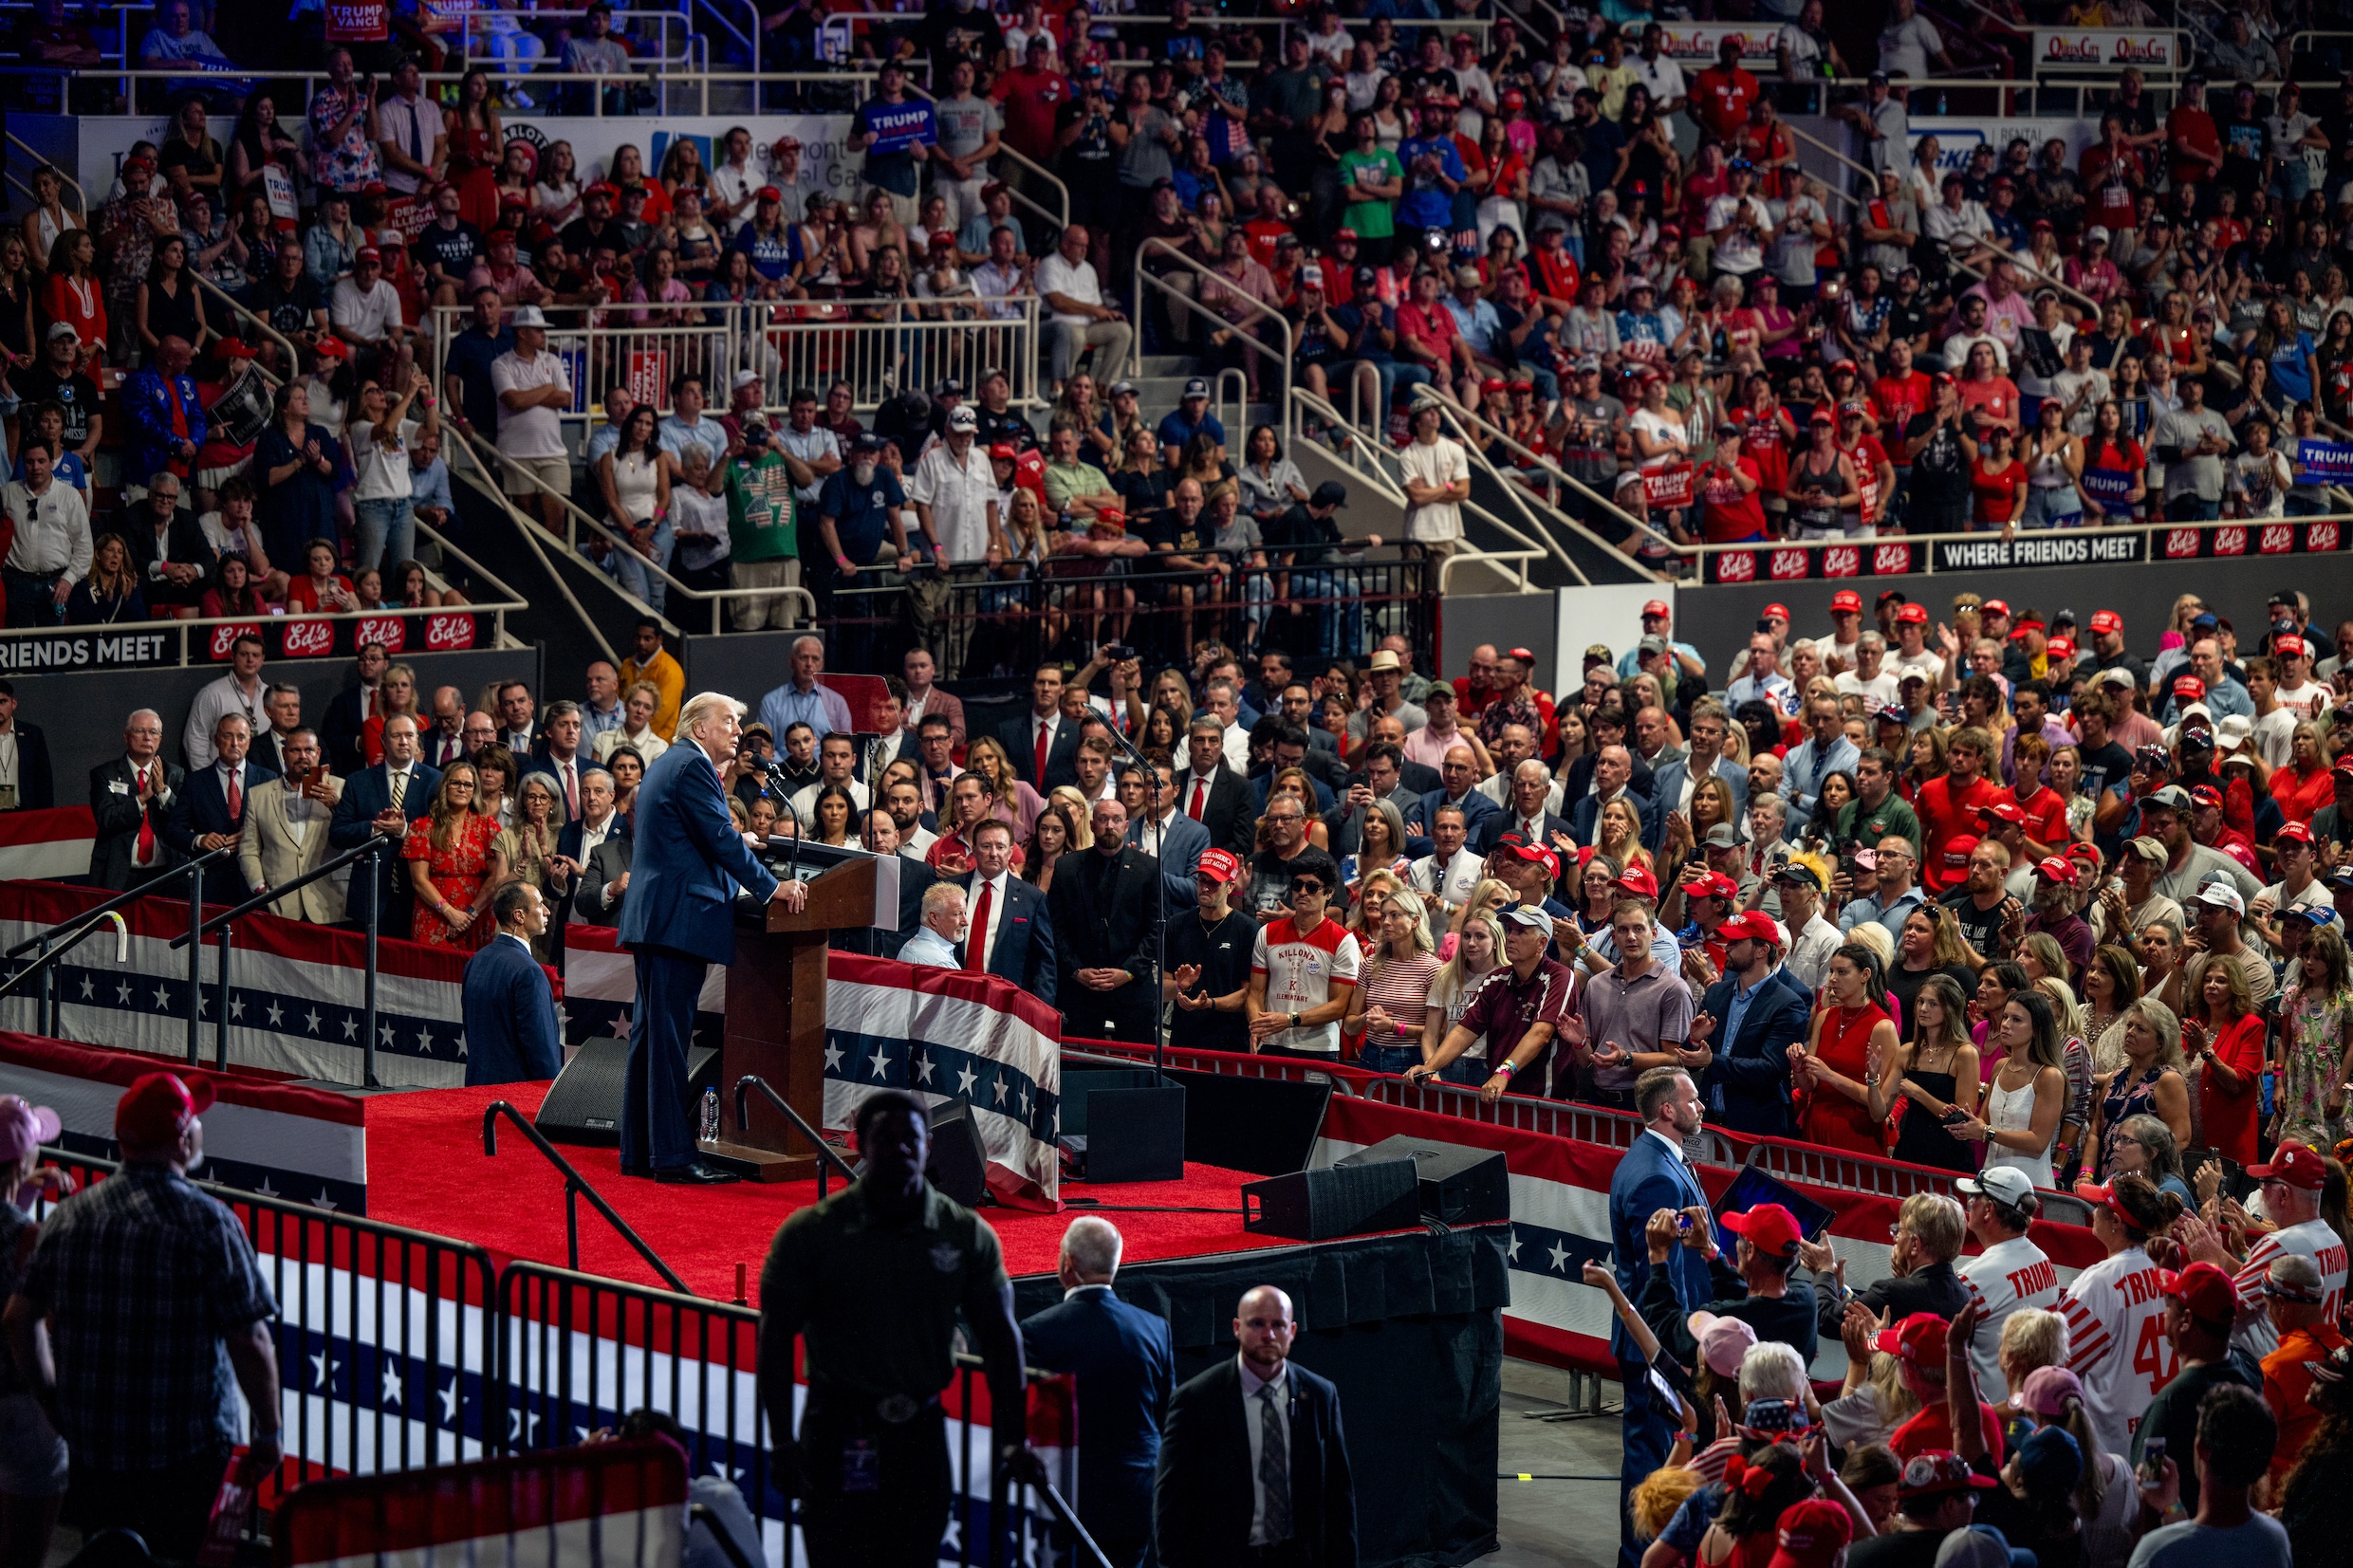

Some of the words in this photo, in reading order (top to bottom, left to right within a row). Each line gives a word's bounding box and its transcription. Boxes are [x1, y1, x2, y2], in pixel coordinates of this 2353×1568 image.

[331, 5, 383, 18] TRUMP
[337, 17, 380, 27] VANCE
[145, 124, 169, 138] FAMIL
[871, 110, 929, 130] TRUMP
[880, 123, 925, 138] VANCE
[503, 124, 549, 151] ARLOTT
[2000, 127, 2044, 141] RENTAL
[392, 212, 438, 229] ILLEGAL
[394, 202, 435, 218] DEPOR
[435, 241, 474, 252] TRUMP
[223, 376, 258, 416] NEVER
[1646, 470, 1691, 489] TRUMP
[1651, 484, 1687, 499] VANCE
[2084, 474, 2128, 492] TRUMP
[744, 492, 792, 529] 47
[2168, 528, 2199, 553] Ed's
[2214, 526, 2246, 551] Ed's
[2261, 525, 2292, 549] Ed's
[2307, 522, 2339, 546] Ed's
[1824, 547, 1859, 573] Ed's
[1876, 544, 1910, 569] Ed's
[1944, 542, 2010, 566] WHERE
[2014, 539, 2087, 563] FRIENDS
[2091, 535, 2138, 561] MEET
[1719, 551, 1754, 578] Ed's
[1771, 550, 1807, 576] Ed's
[287, 622, 330, 650] Ed's
[358, 618, 402, 648] Ed's
[429, 616, 472, 644] Ed's
[0, 638, 90, 670] RIENDS
[98, 635, 166, 664] MEET
[1212, 852, 1232, 866] AMERICA
[1212, 860, 1229, 872] AGAIN
[1278, 949, 1316, 963] KILLONA
[1288, 980, 1297, 991] K
[1276, 993, 1309, 1003] ELEMENTARY
[2315, 1244, 2349, 1278] TRUM
[2113, 1266, 2164, 1309] TRU
